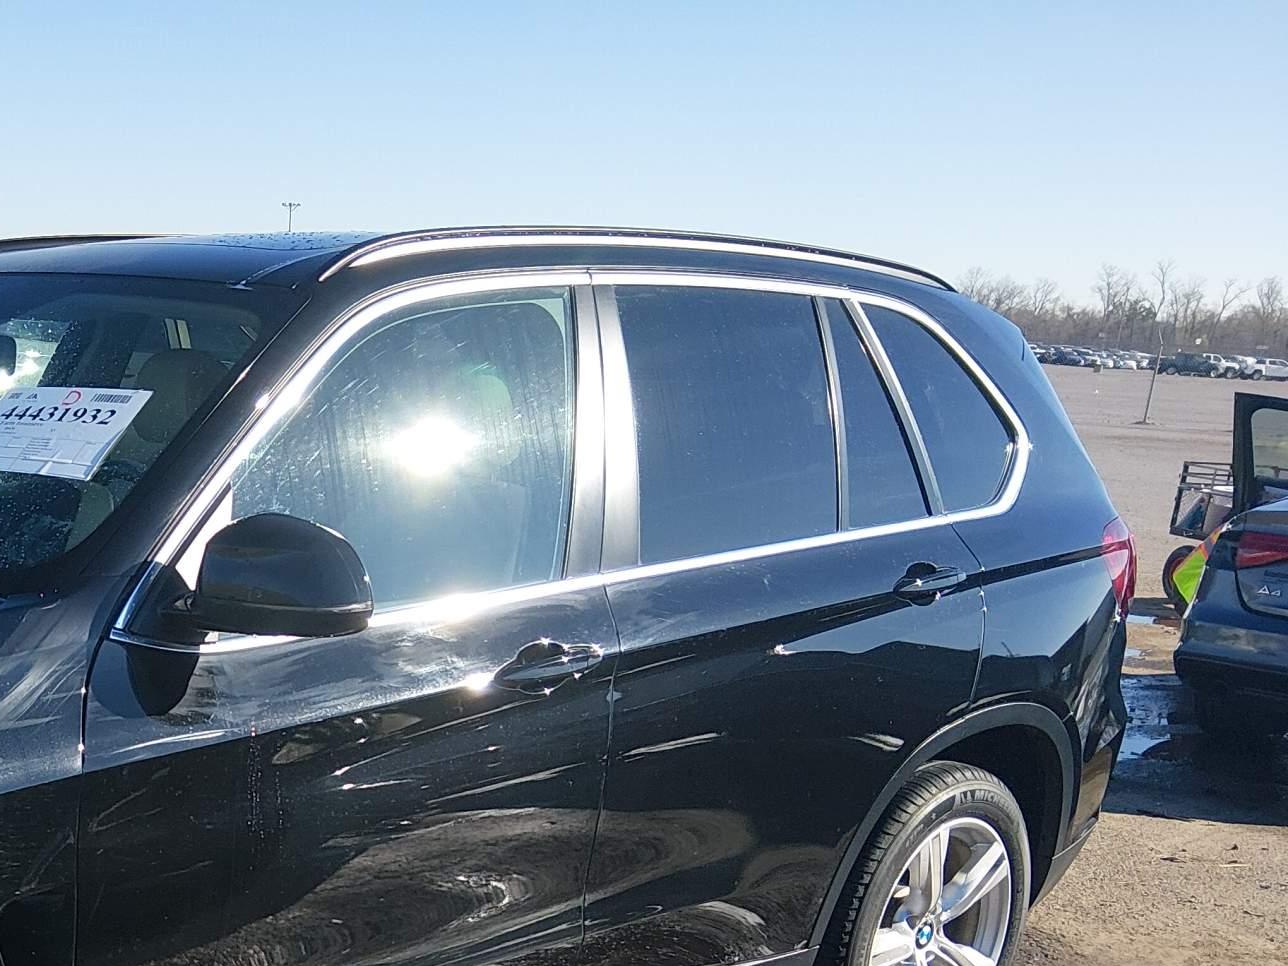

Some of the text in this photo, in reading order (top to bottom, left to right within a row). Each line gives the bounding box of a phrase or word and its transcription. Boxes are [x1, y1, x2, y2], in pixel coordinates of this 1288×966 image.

[62, 390, 81, 406] D
[1, 405, 117, 425] 44431932
[1256, 585, 1281, 597] A4
